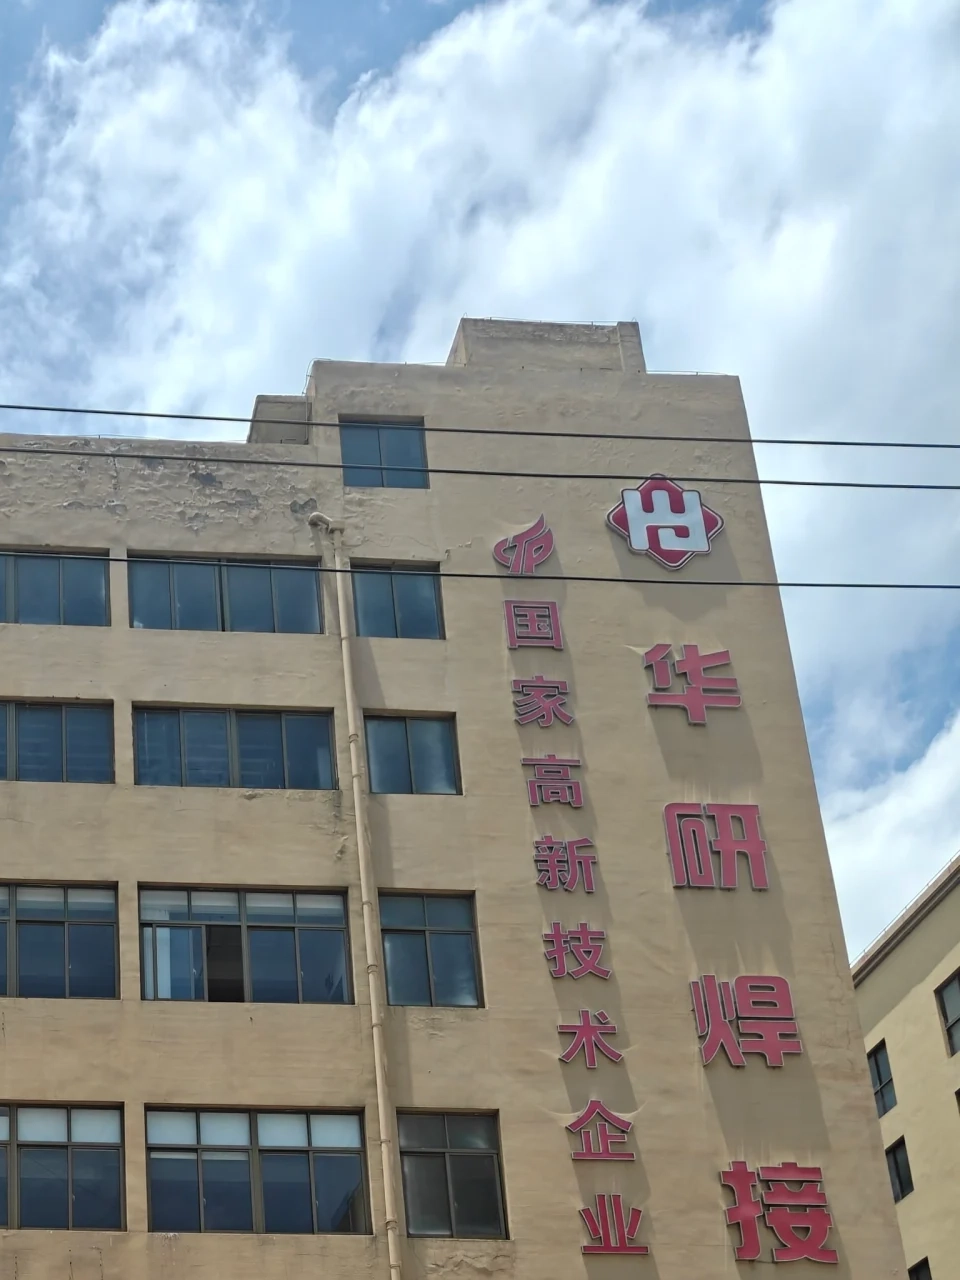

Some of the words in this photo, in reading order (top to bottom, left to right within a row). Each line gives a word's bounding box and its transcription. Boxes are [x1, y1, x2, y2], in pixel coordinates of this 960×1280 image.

[504, 600, 651, 1256] 国家高新技术企业
[644, 643, 839, 1264] 华研焊接
